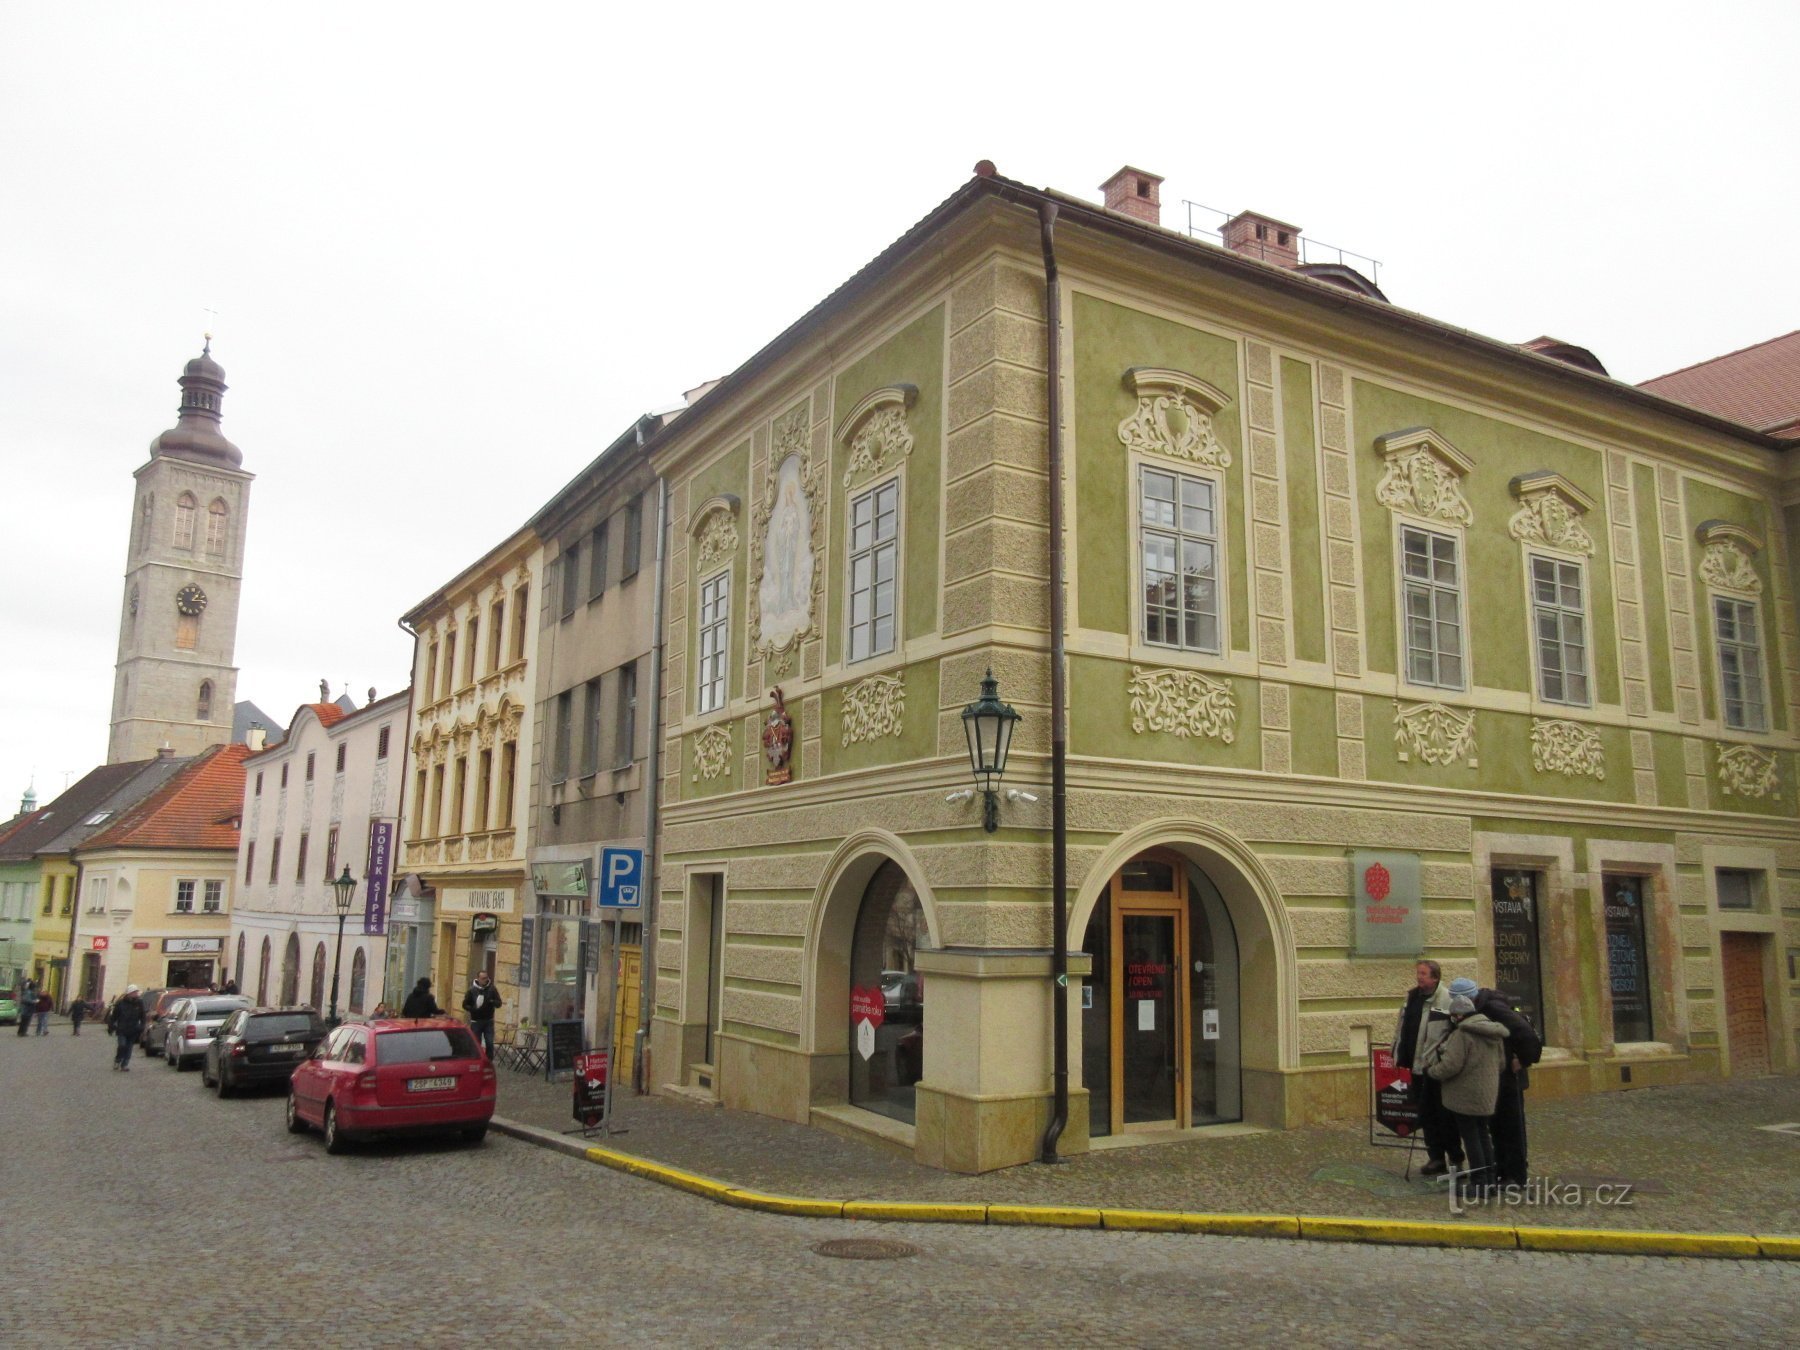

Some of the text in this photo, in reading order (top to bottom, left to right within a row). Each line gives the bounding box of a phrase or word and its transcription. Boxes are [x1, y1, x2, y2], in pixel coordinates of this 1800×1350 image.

[370, 824, 387, 933] BOŘEK ŠÍPEK
[608, 854, 635, 889] P
[1133, 975, 1153, 986] OPEN
